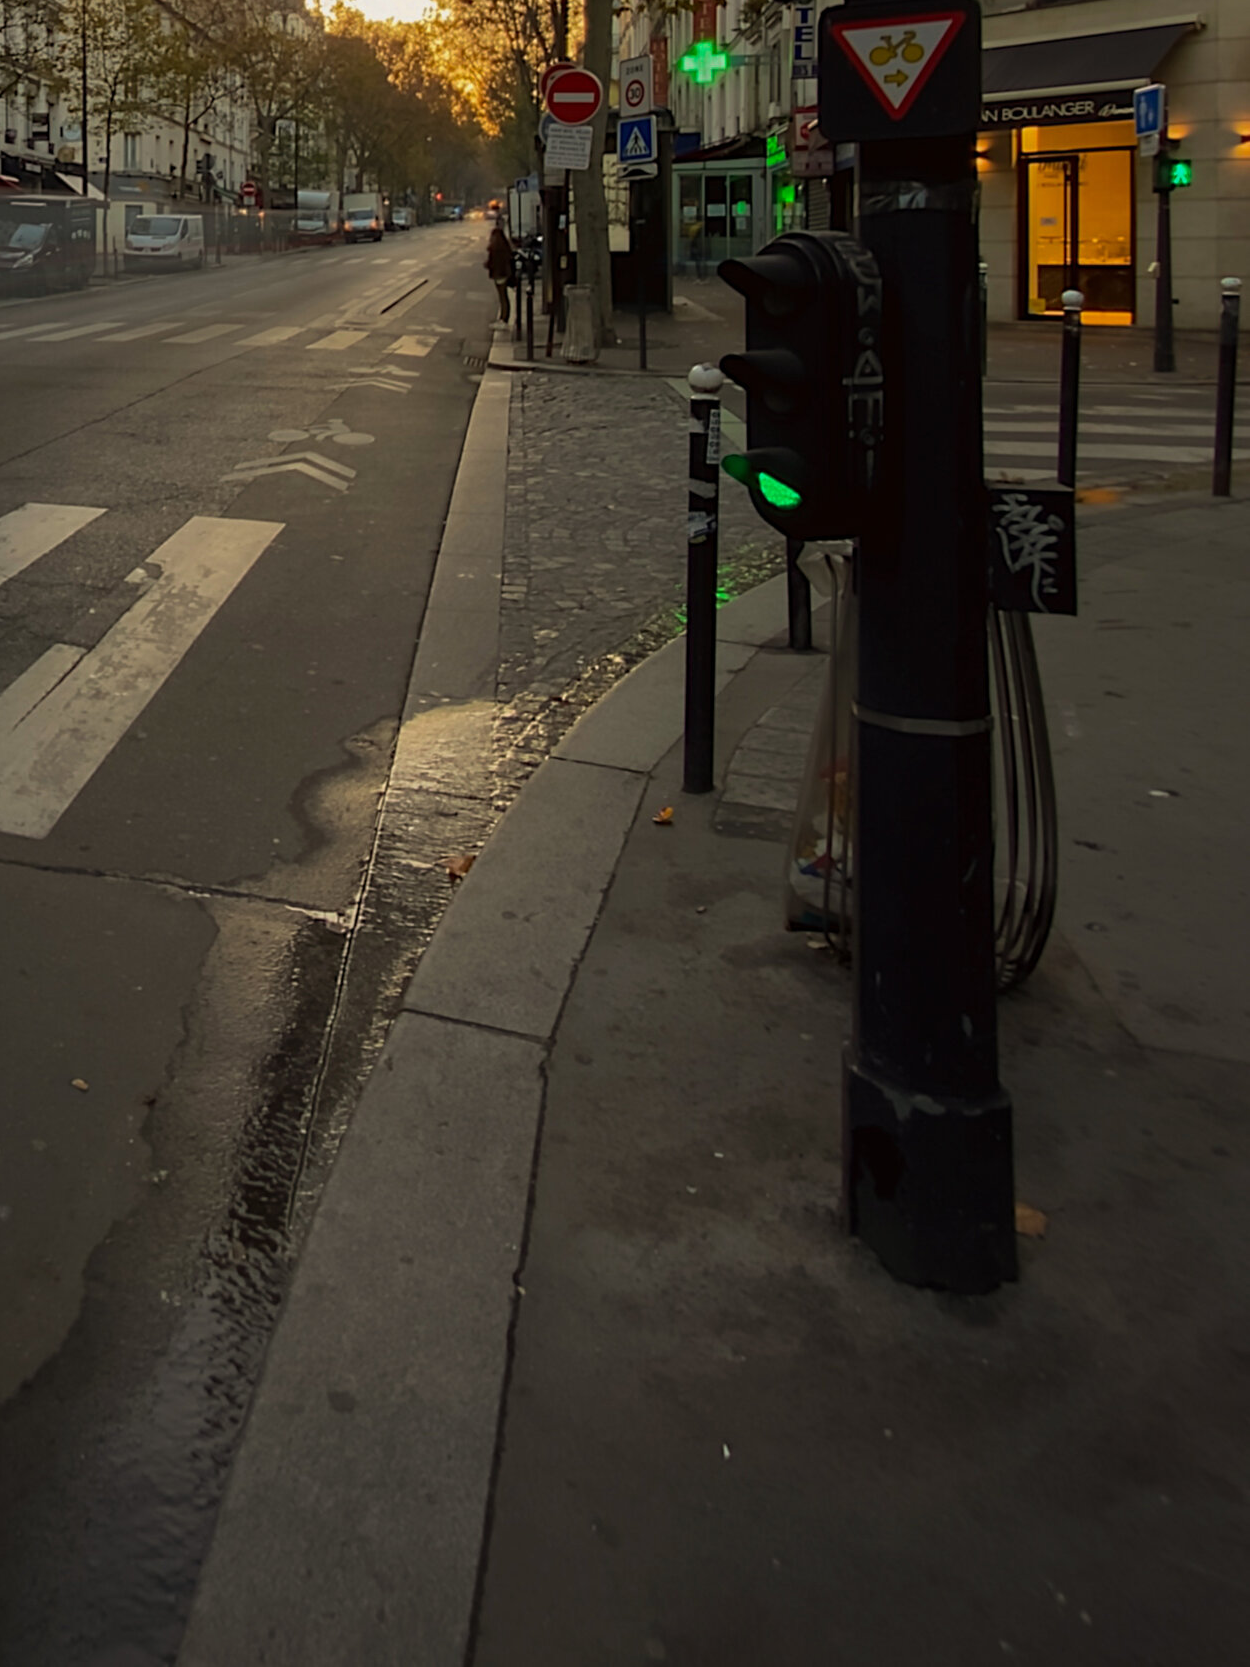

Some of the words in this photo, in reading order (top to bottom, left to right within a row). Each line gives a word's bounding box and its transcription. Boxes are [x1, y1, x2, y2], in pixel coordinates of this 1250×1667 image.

[626, 64, 643, 75] ZONE
[630, 87, 641, 99] 30
[1001, 100, 1095, 121] BOULANGER
